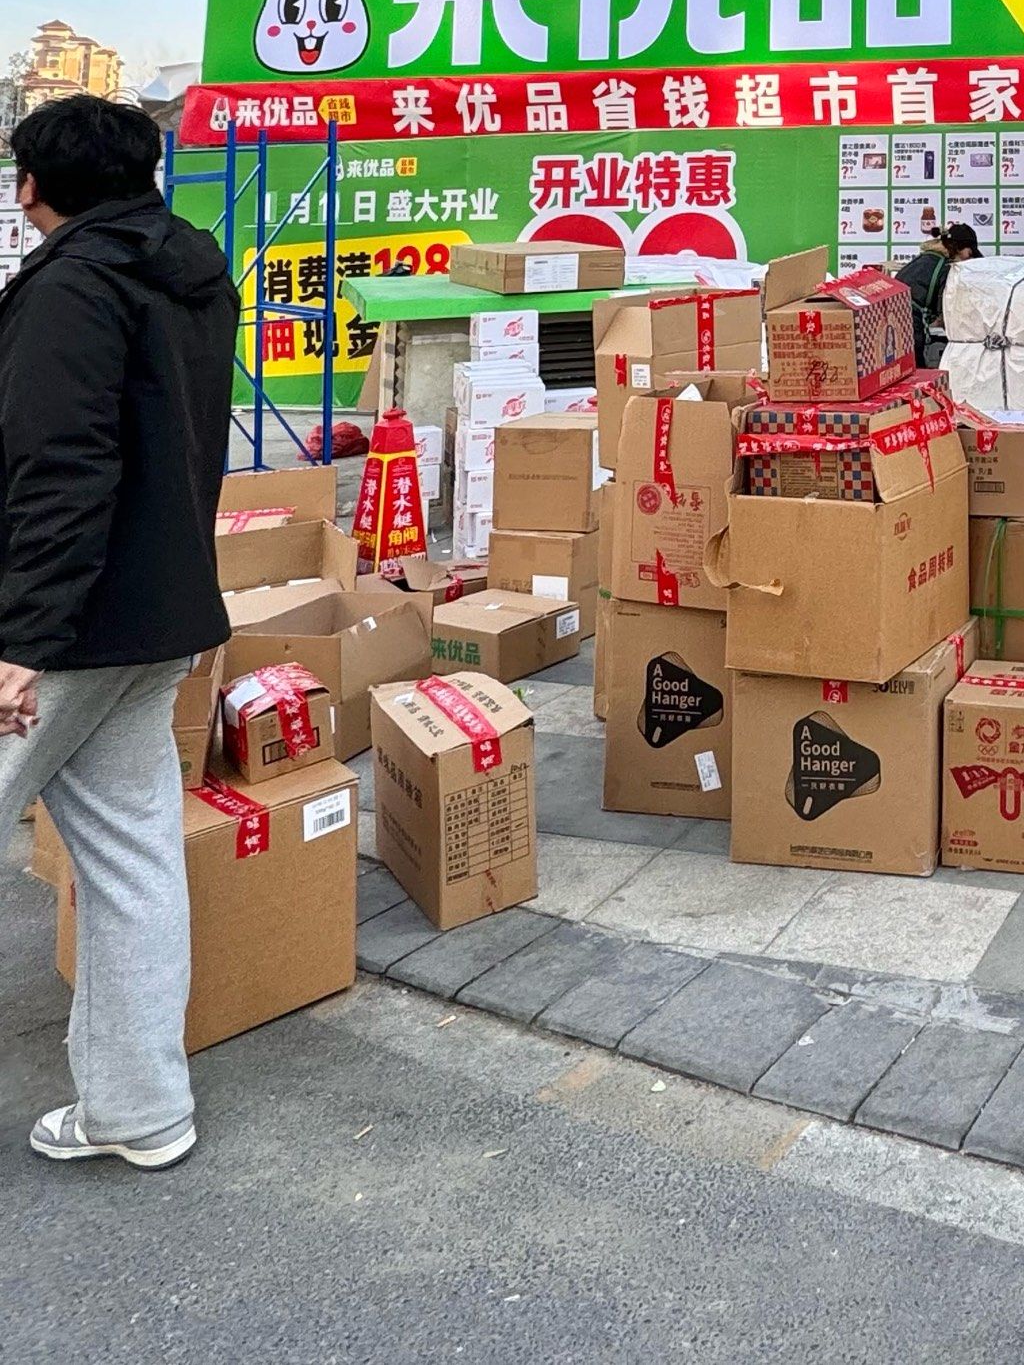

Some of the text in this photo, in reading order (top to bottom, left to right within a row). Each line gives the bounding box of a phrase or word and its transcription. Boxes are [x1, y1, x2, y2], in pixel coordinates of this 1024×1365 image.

[236, 97, 318, 128] 来优品
[347, 158, 394, 178] 来优品
[534, 155, 732, 209] 开业特惠
[391, 477, 414, 528] 潜水艇
[908, 545, 954, 592] 食品周转箱
[430, 637, 481, 666] 来优品
[653, 664, 663, 677] A
[652, 678, 689, 692] Good
[652, 691, 702, 709] Hanger
[801, 725, 811, 740] A
[801, 741, 840, 756] Good
[801, 756, 856, 776] Hanger
